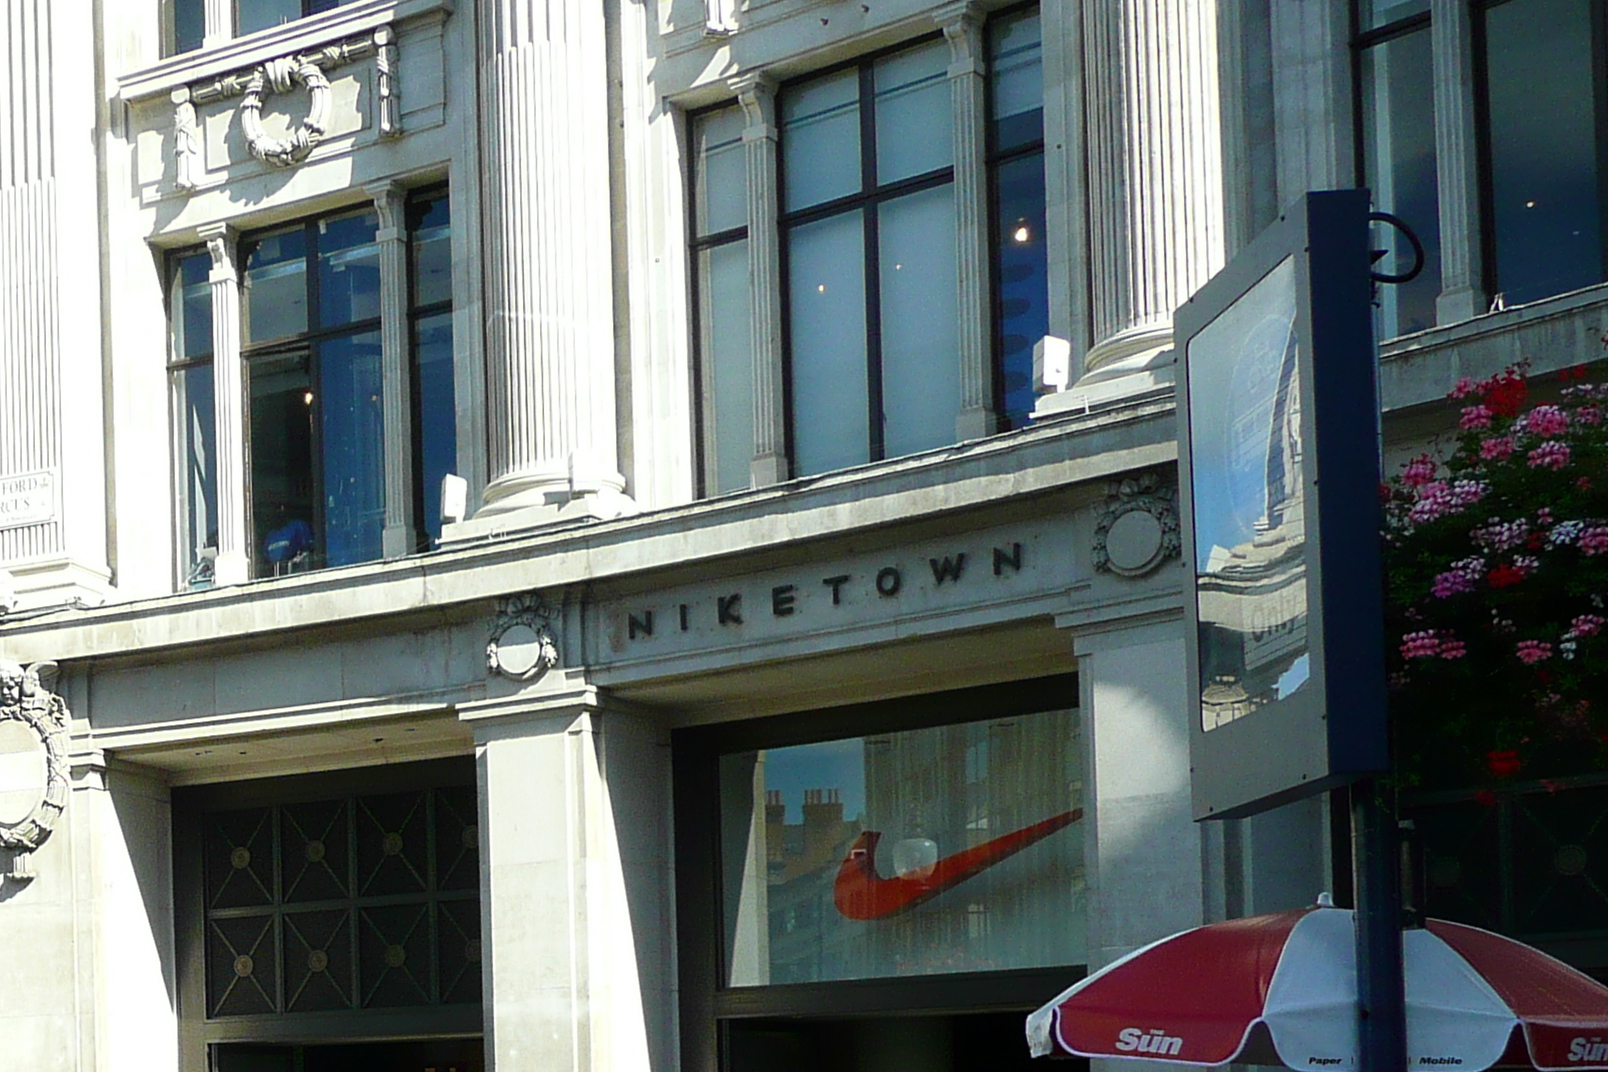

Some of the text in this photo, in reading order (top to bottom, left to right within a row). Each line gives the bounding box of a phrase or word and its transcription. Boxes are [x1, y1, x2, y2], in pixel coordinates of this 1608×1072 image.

[628, 542, 1021, 640] NIKETOWN
[1115, 1027, 1183, 1055] Sun
[1308, 1056, 1463, 1066] Paper Mobile
